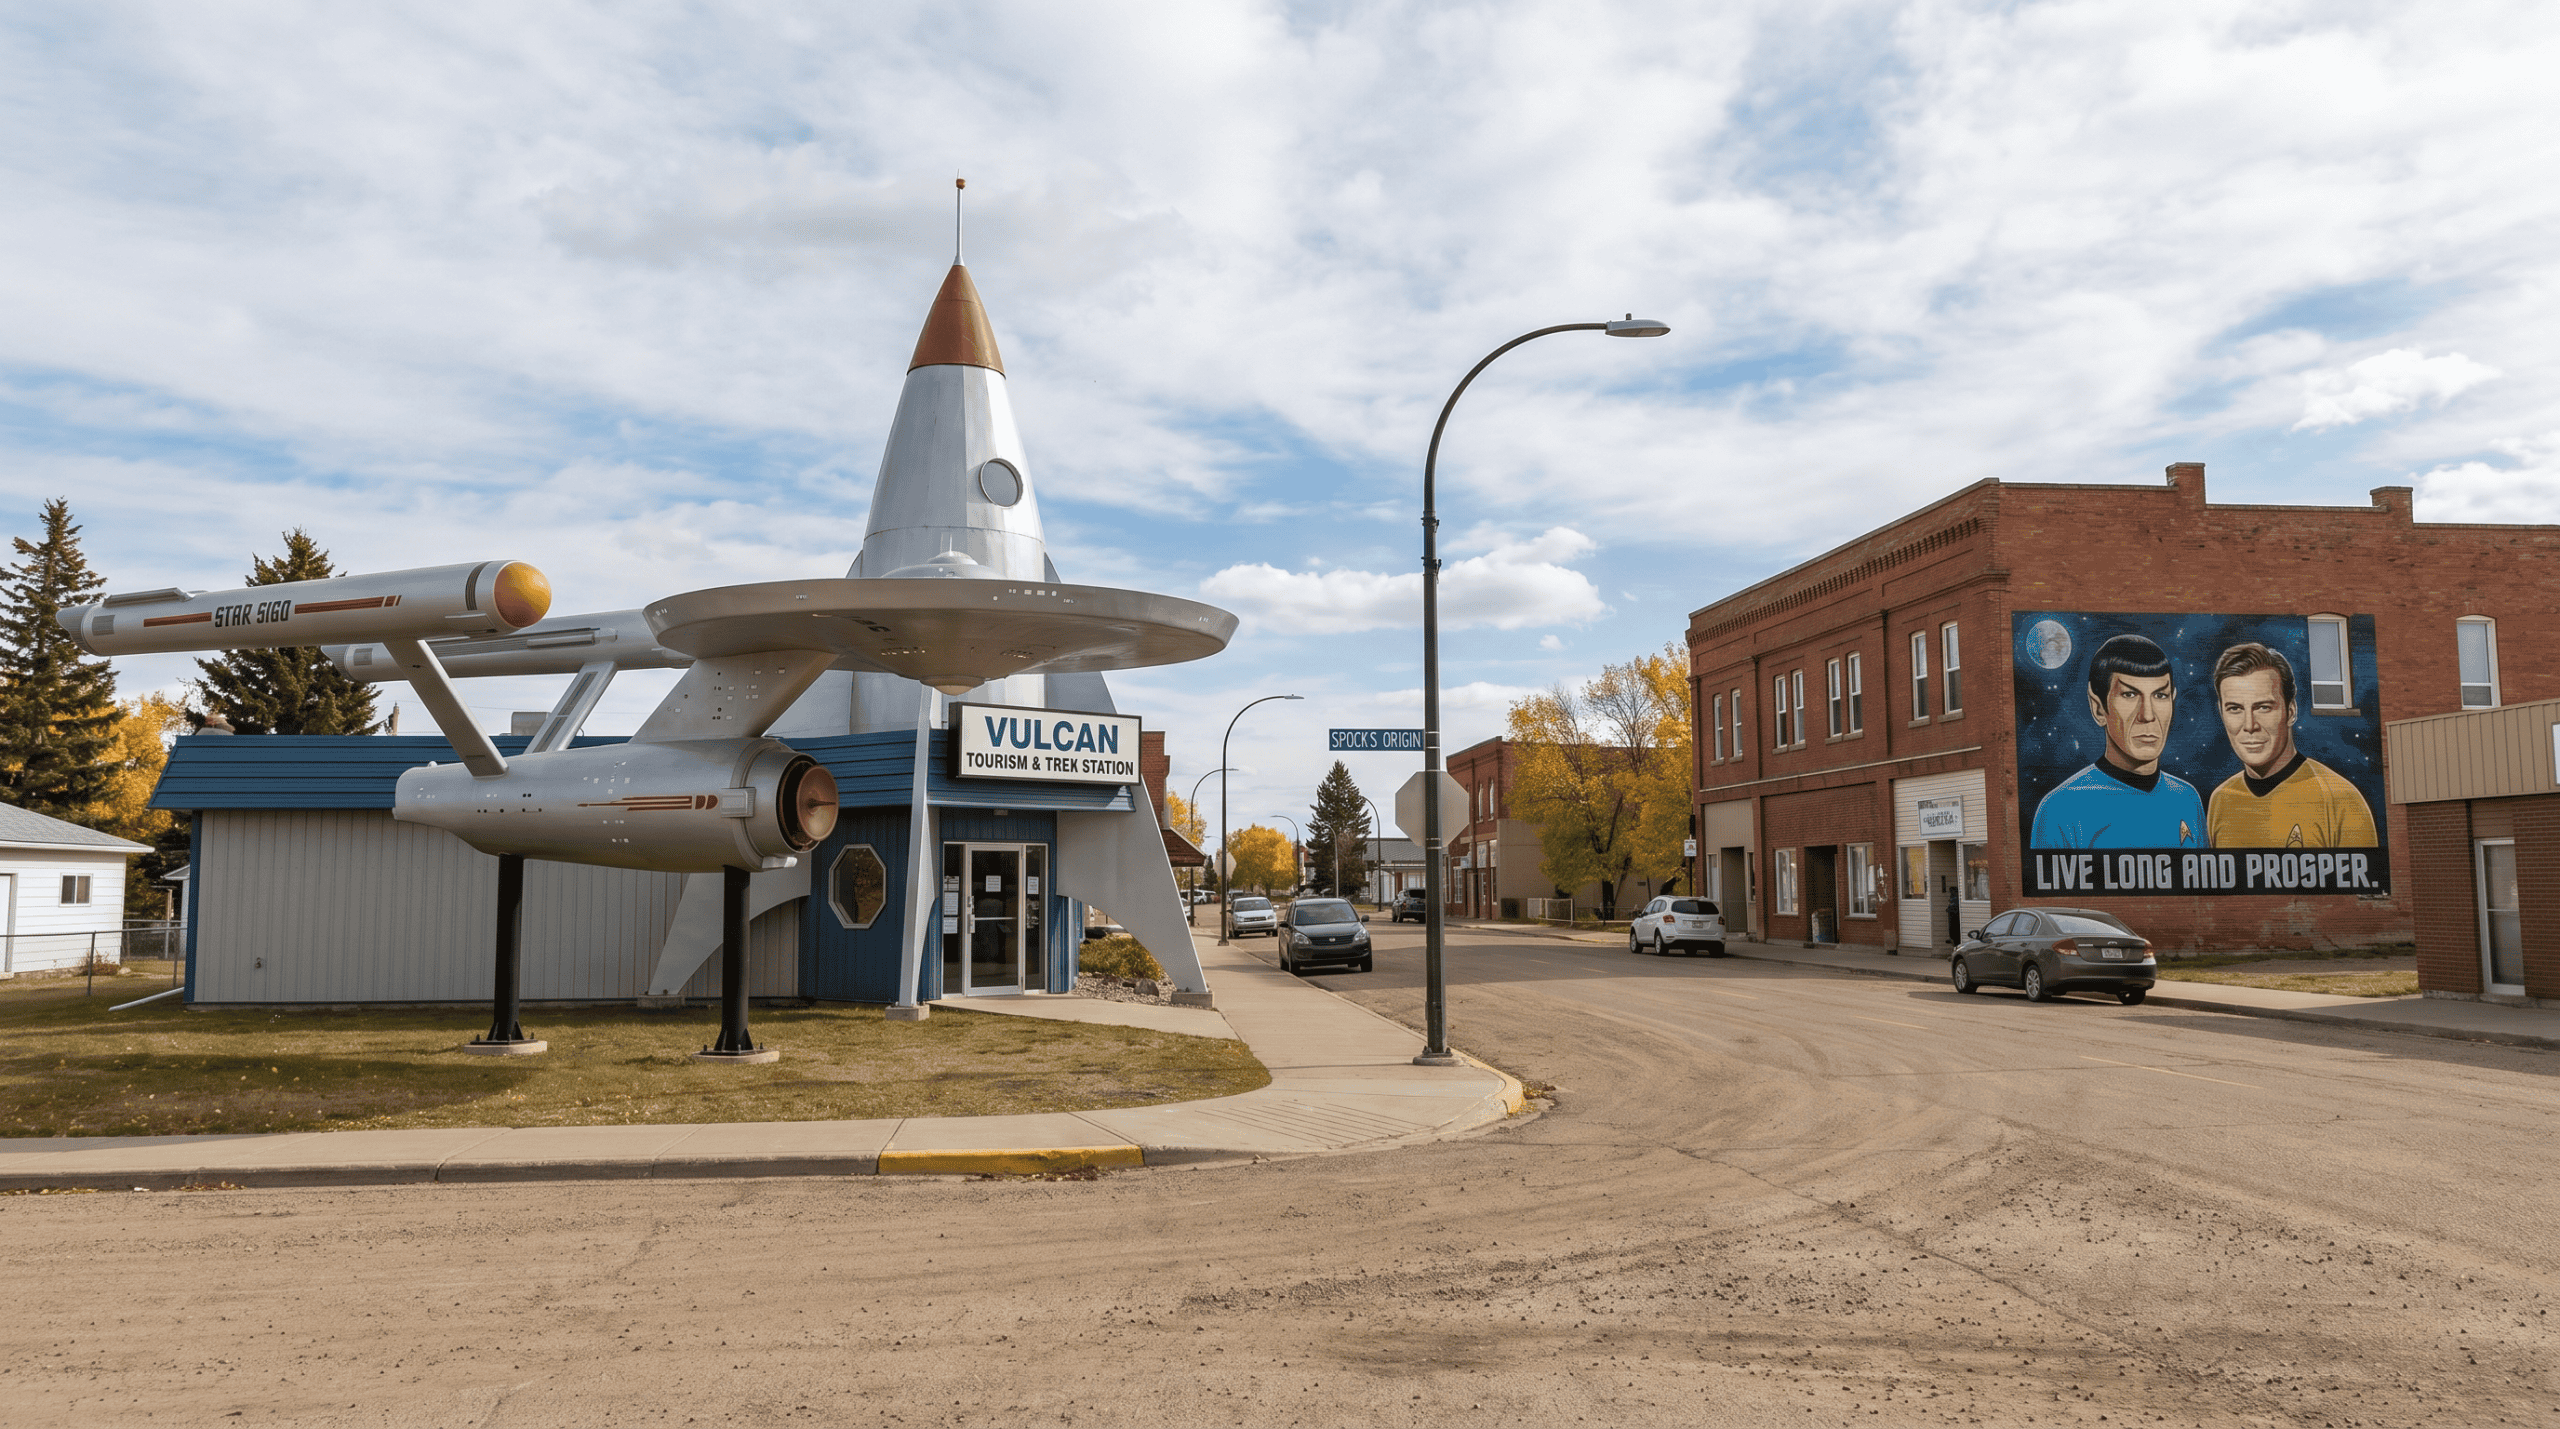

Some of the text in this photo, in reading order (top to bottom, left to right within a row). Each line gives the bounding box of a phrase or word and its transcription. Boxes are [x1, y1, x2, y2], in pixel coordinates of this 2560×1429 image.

[215, 603, 253, 628] STAR
[984, 715, 1118, 754] VULCAN
[1383, 731, 1421, 748] ORIGIN
[966, 752, 1134, 775] TOURISM & TREK STATION
[2036, 853, 2379, 890] LIVE LONG AND PROSPER.
